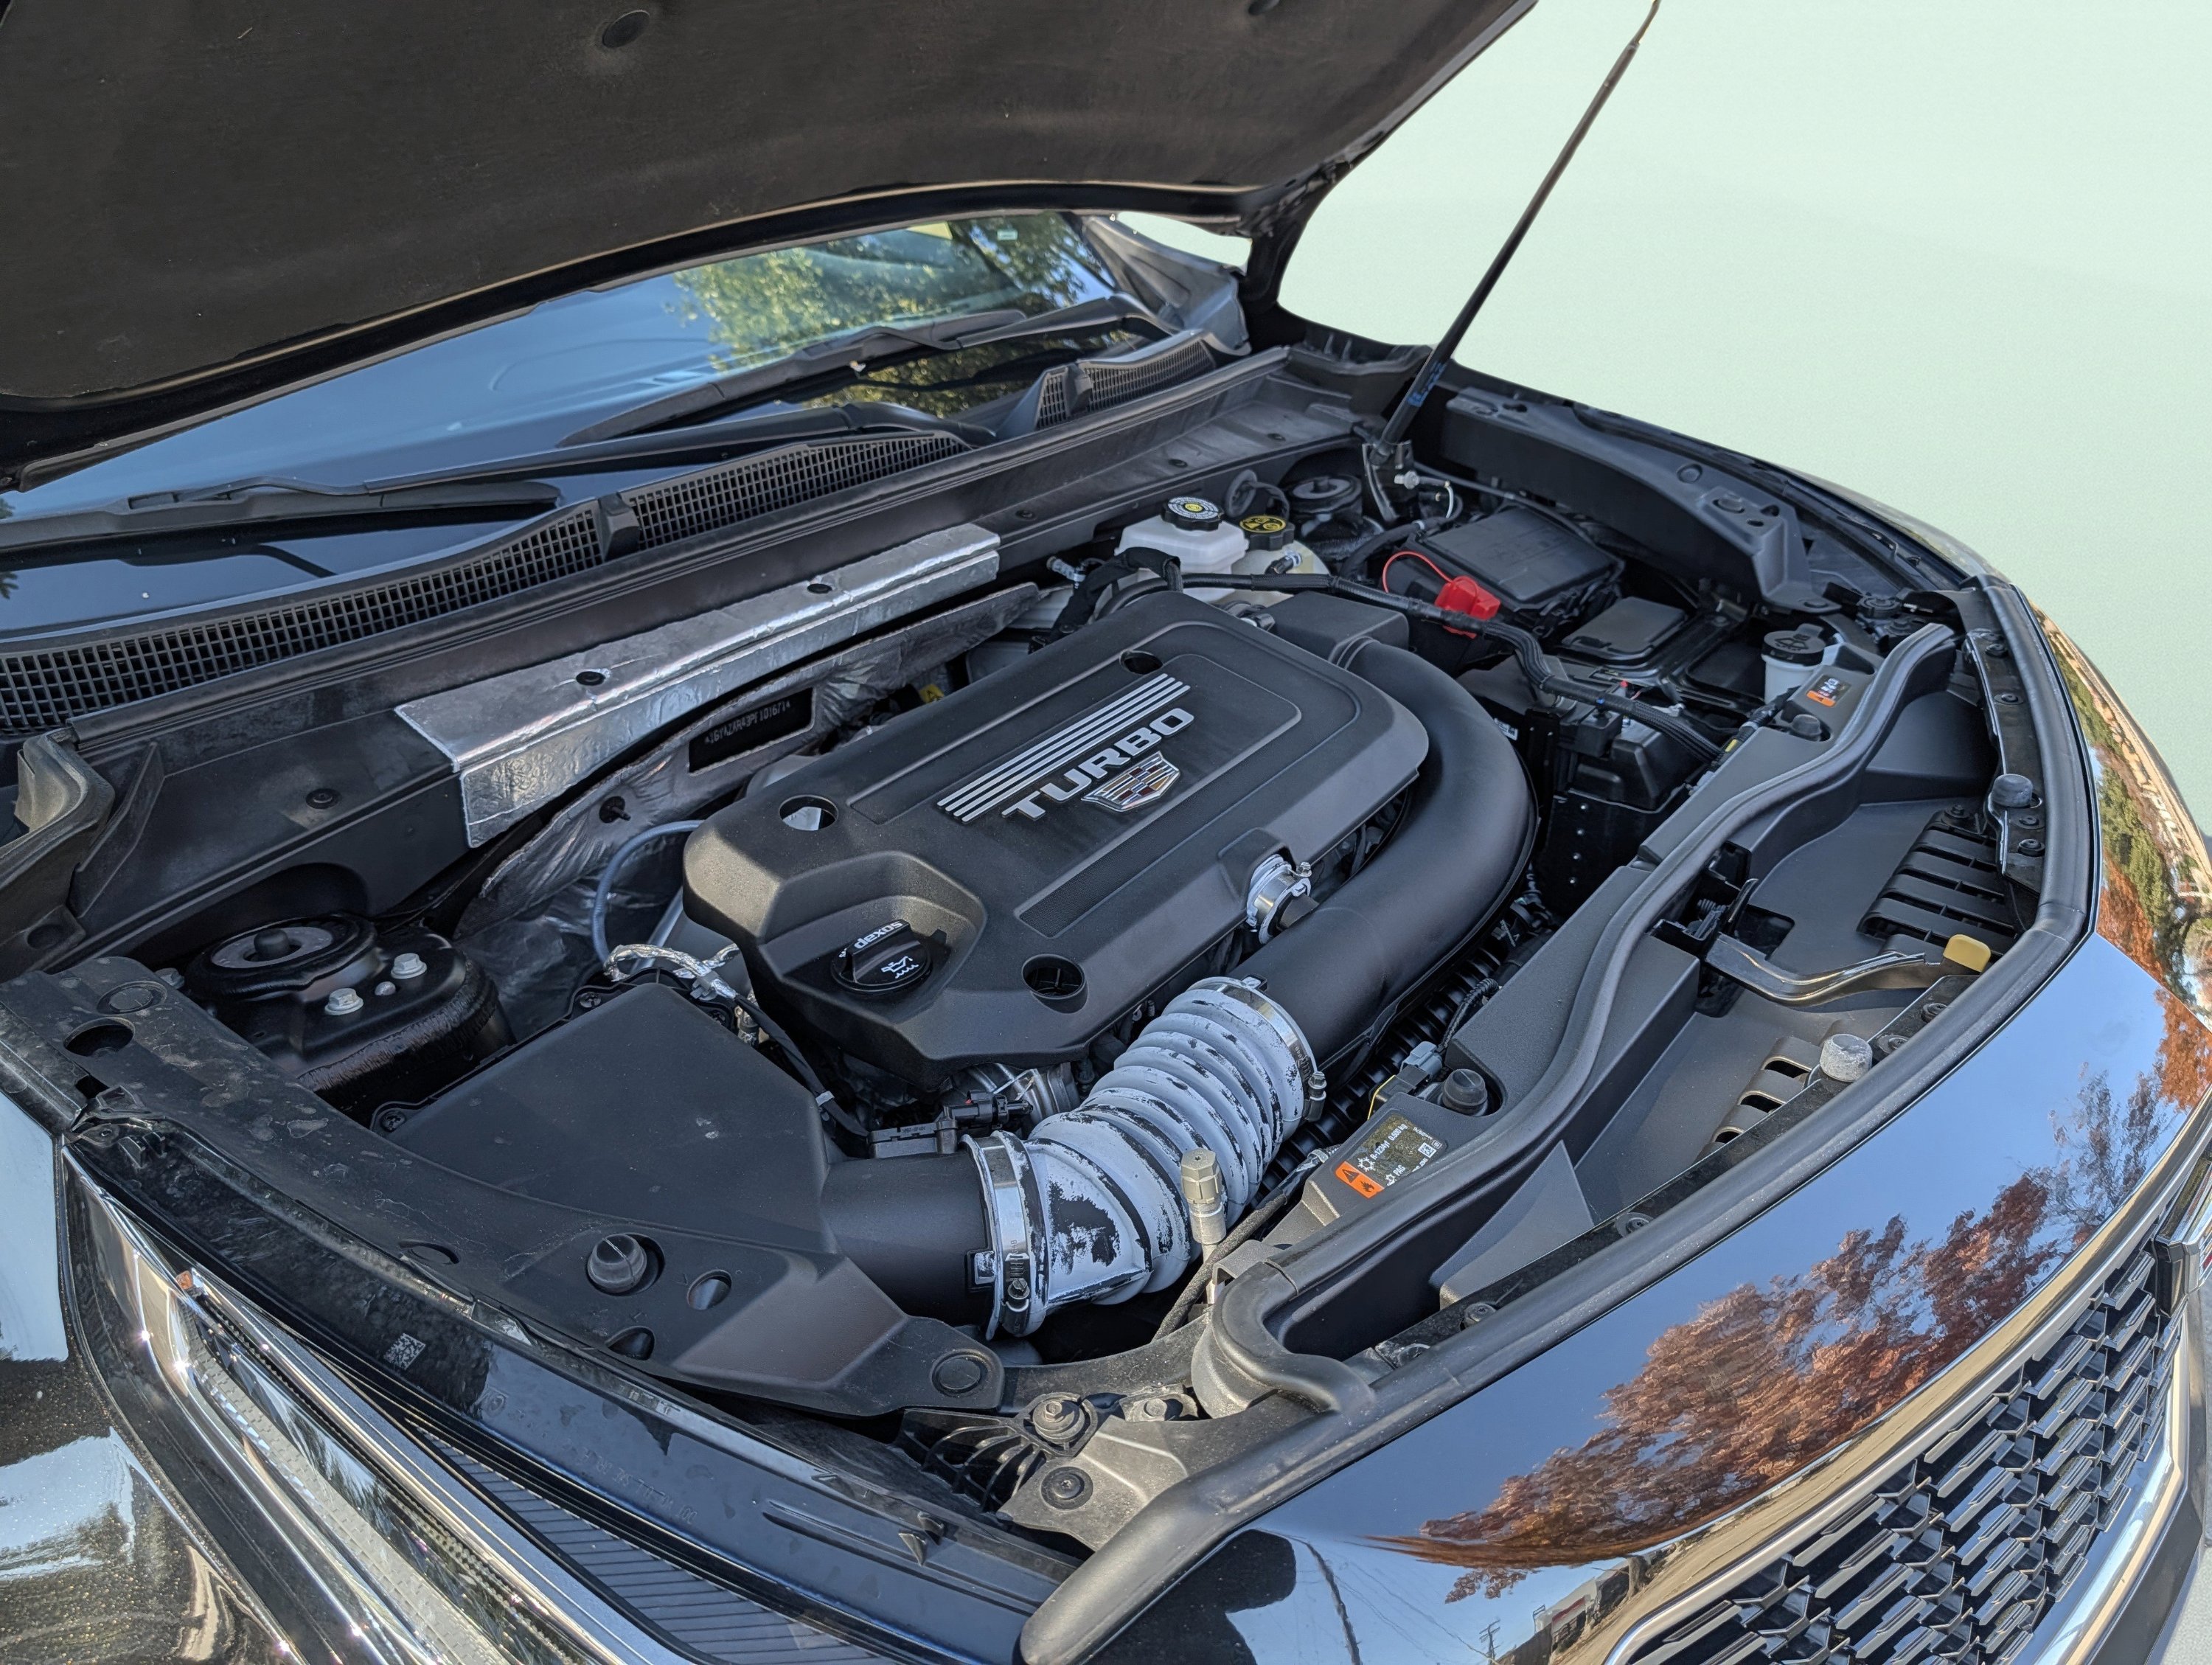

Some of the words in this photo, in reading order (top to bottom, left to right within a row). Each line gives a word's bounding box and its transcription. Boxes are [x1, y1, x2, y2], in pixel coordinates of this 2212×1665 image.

[1001, 707, 1194, 821] TURBO
[854, 921, 903, 949] dexos
[1393, 1164, 1406, 1176] PAG
